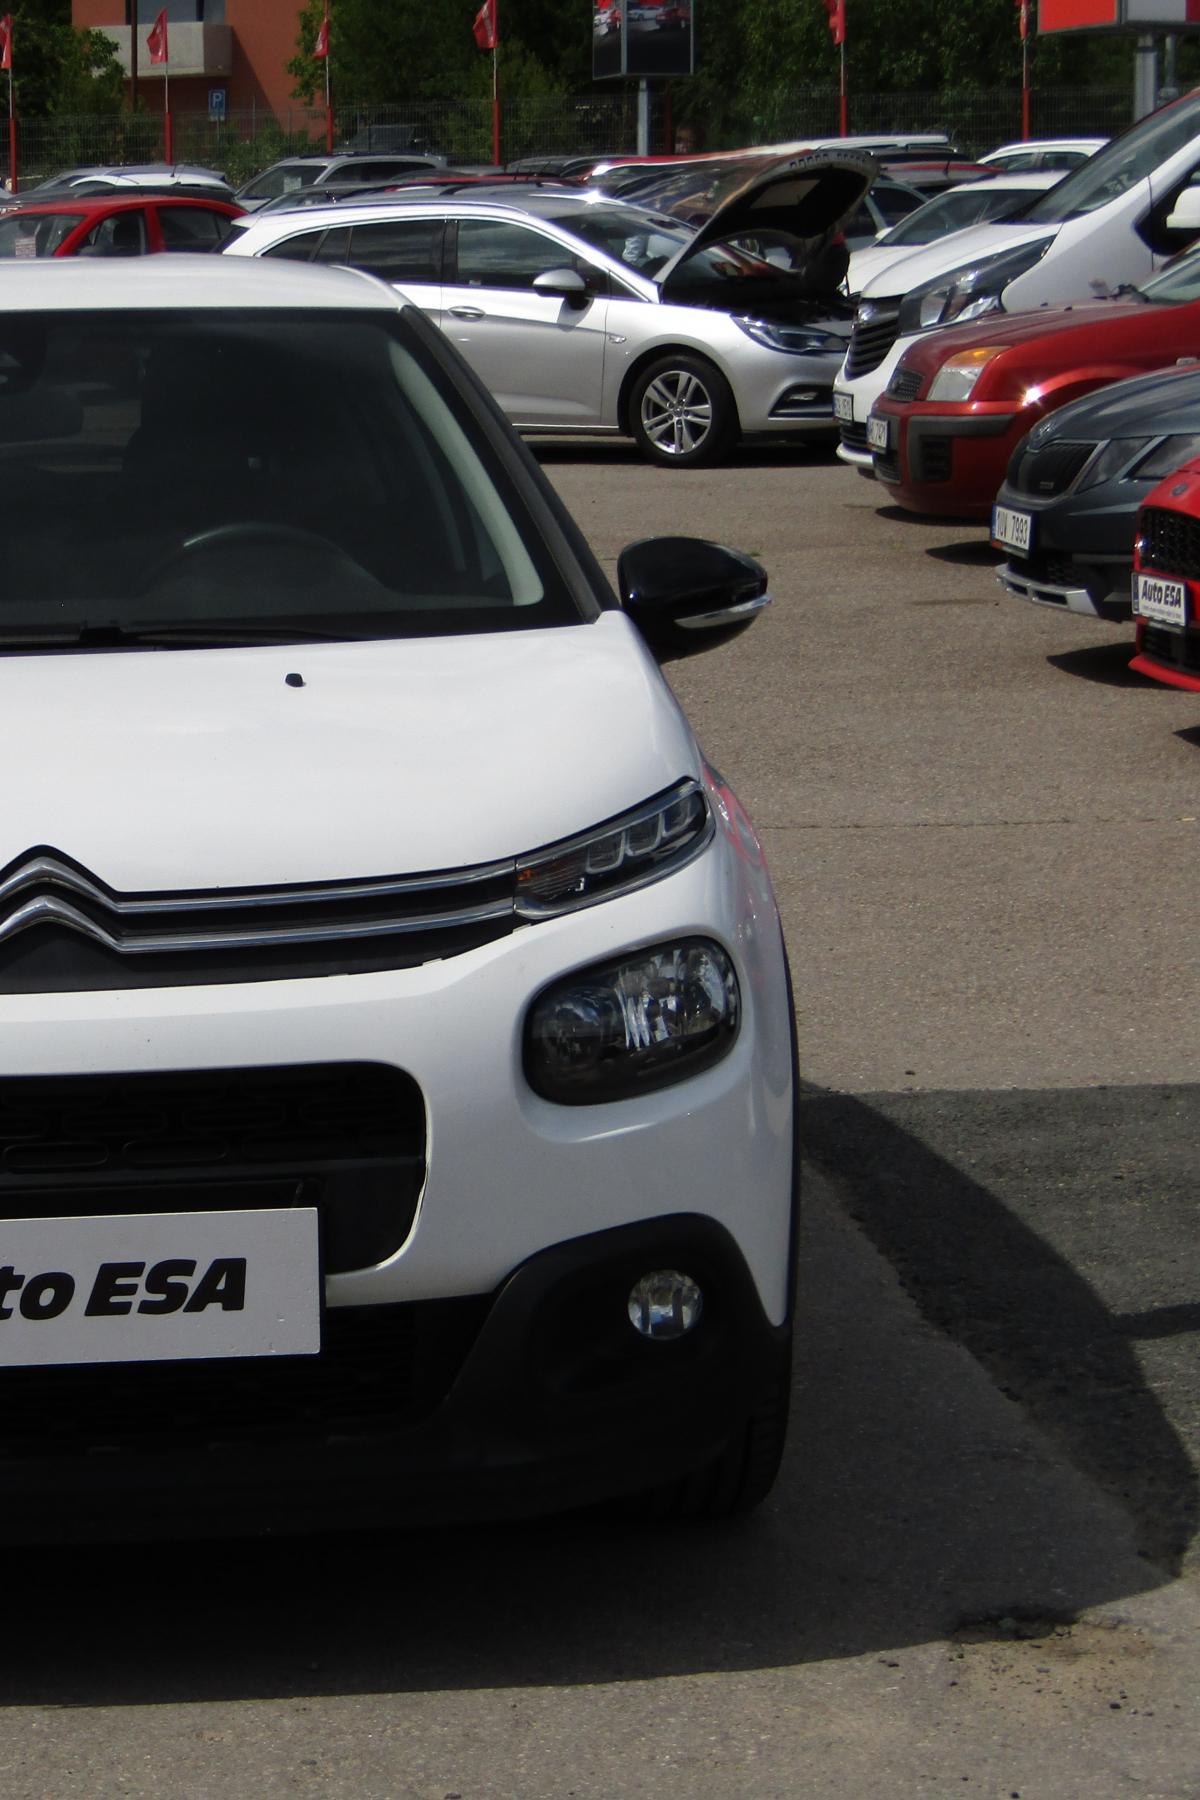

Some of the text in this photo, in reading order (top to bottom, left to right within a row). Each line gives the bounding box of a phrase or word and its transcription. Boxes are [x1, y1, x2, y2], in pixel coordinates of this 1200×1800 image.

[212, 93, 222, 107] P
[1011, 515, 1028, 544] 7993
[1141, 580, 1182, 608] Auto ESA
[84, 1257, 247, 1317] ESA
